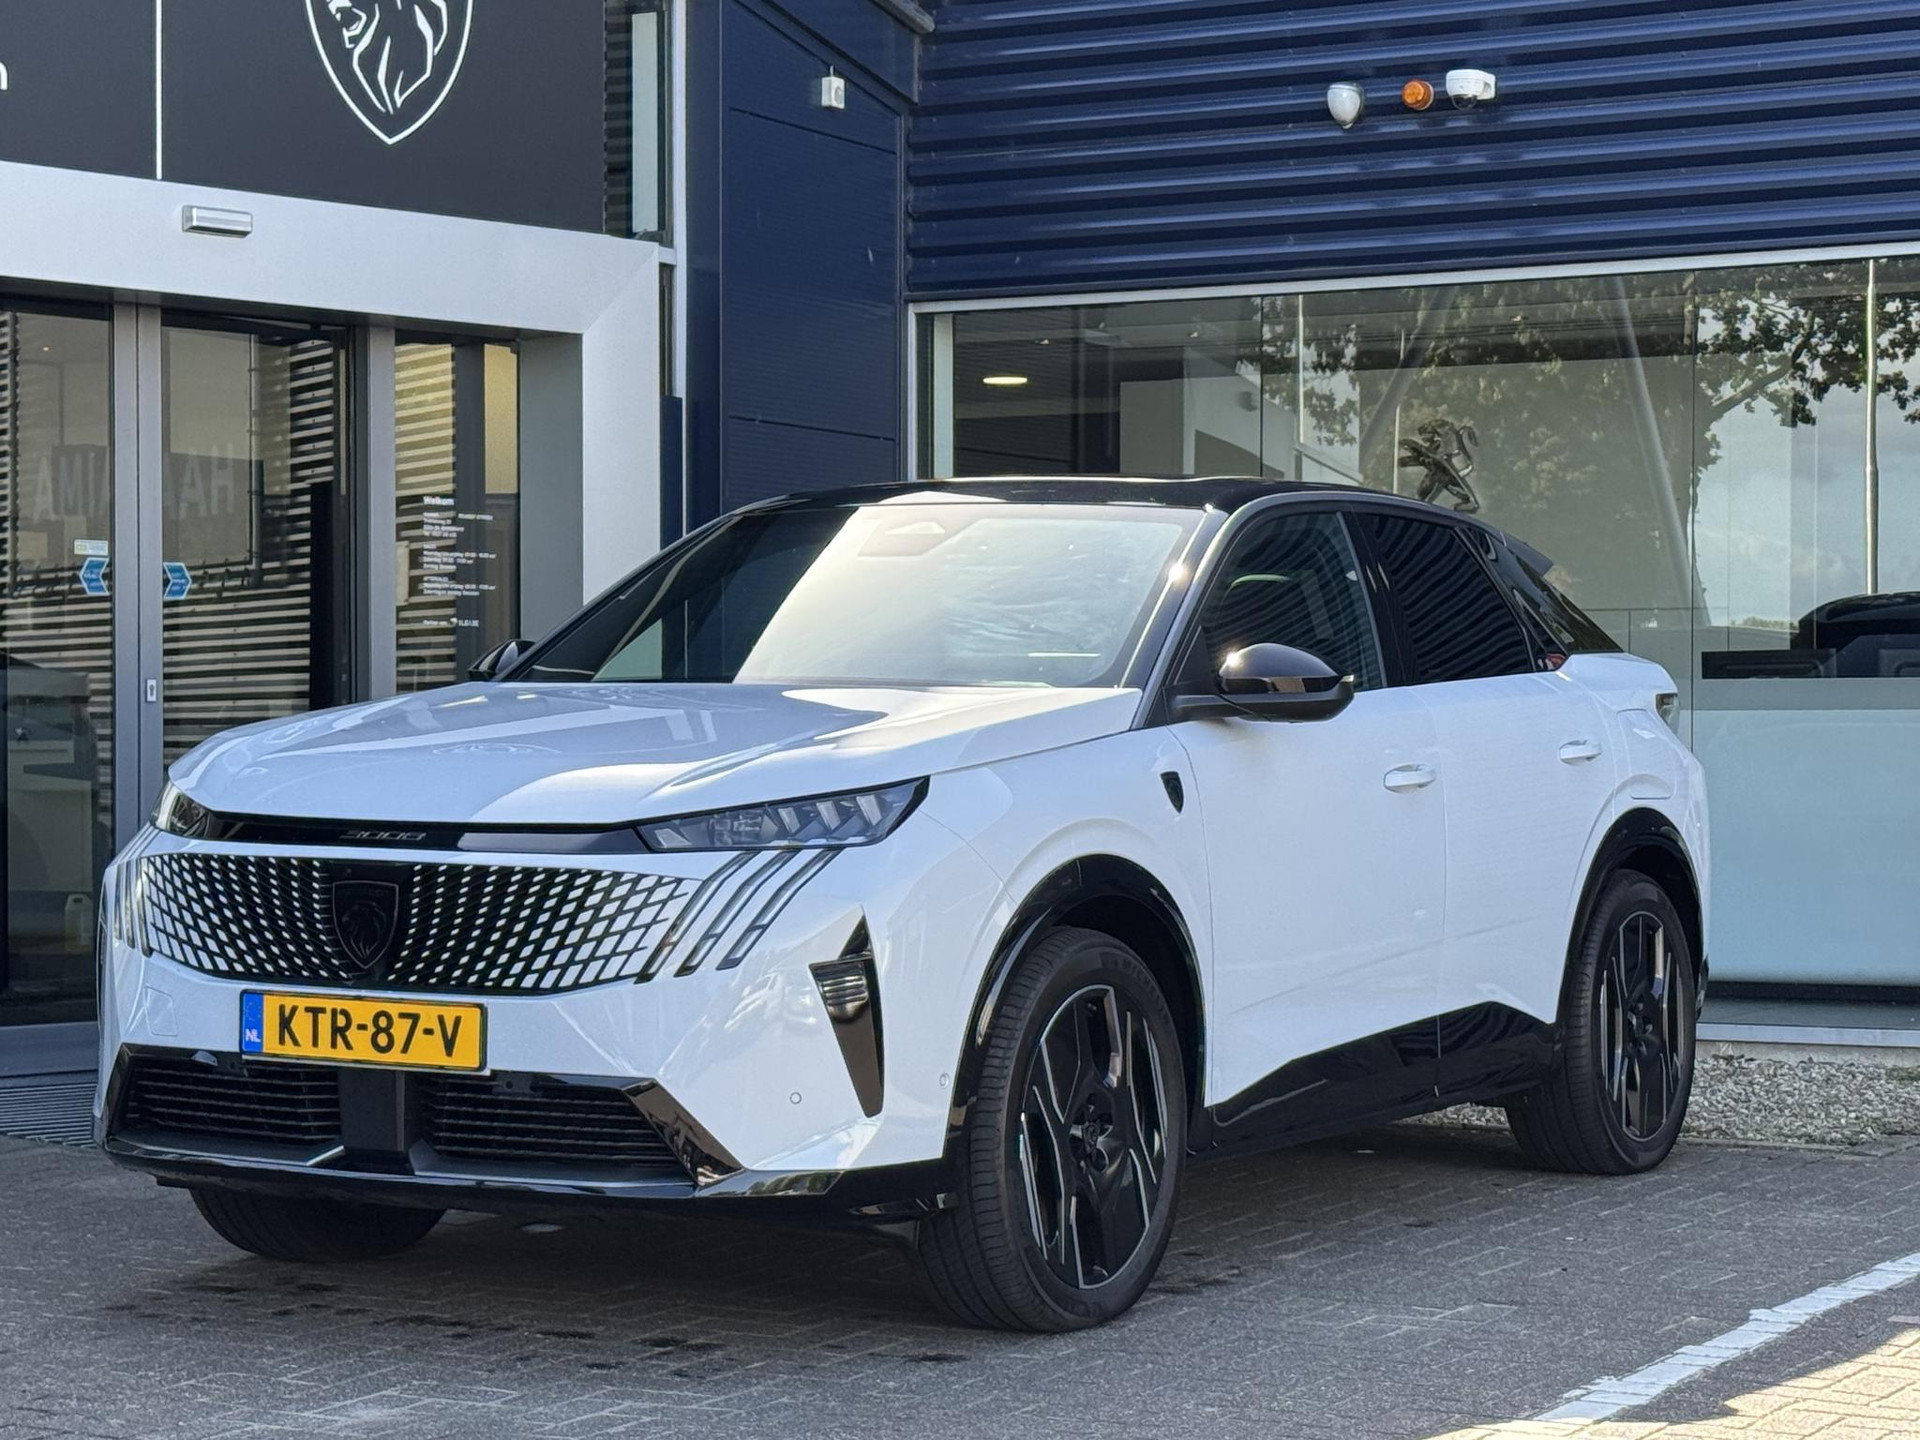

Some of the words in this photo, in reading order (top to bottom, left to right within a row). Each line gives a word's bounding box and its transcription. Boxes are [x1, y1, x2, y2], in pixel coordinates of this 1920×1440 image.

[423, 496, 454, 505] Welkom
[245, 1028, 262, 1043] NL
[278, 1003, 462, 1058] KTR-87-V
